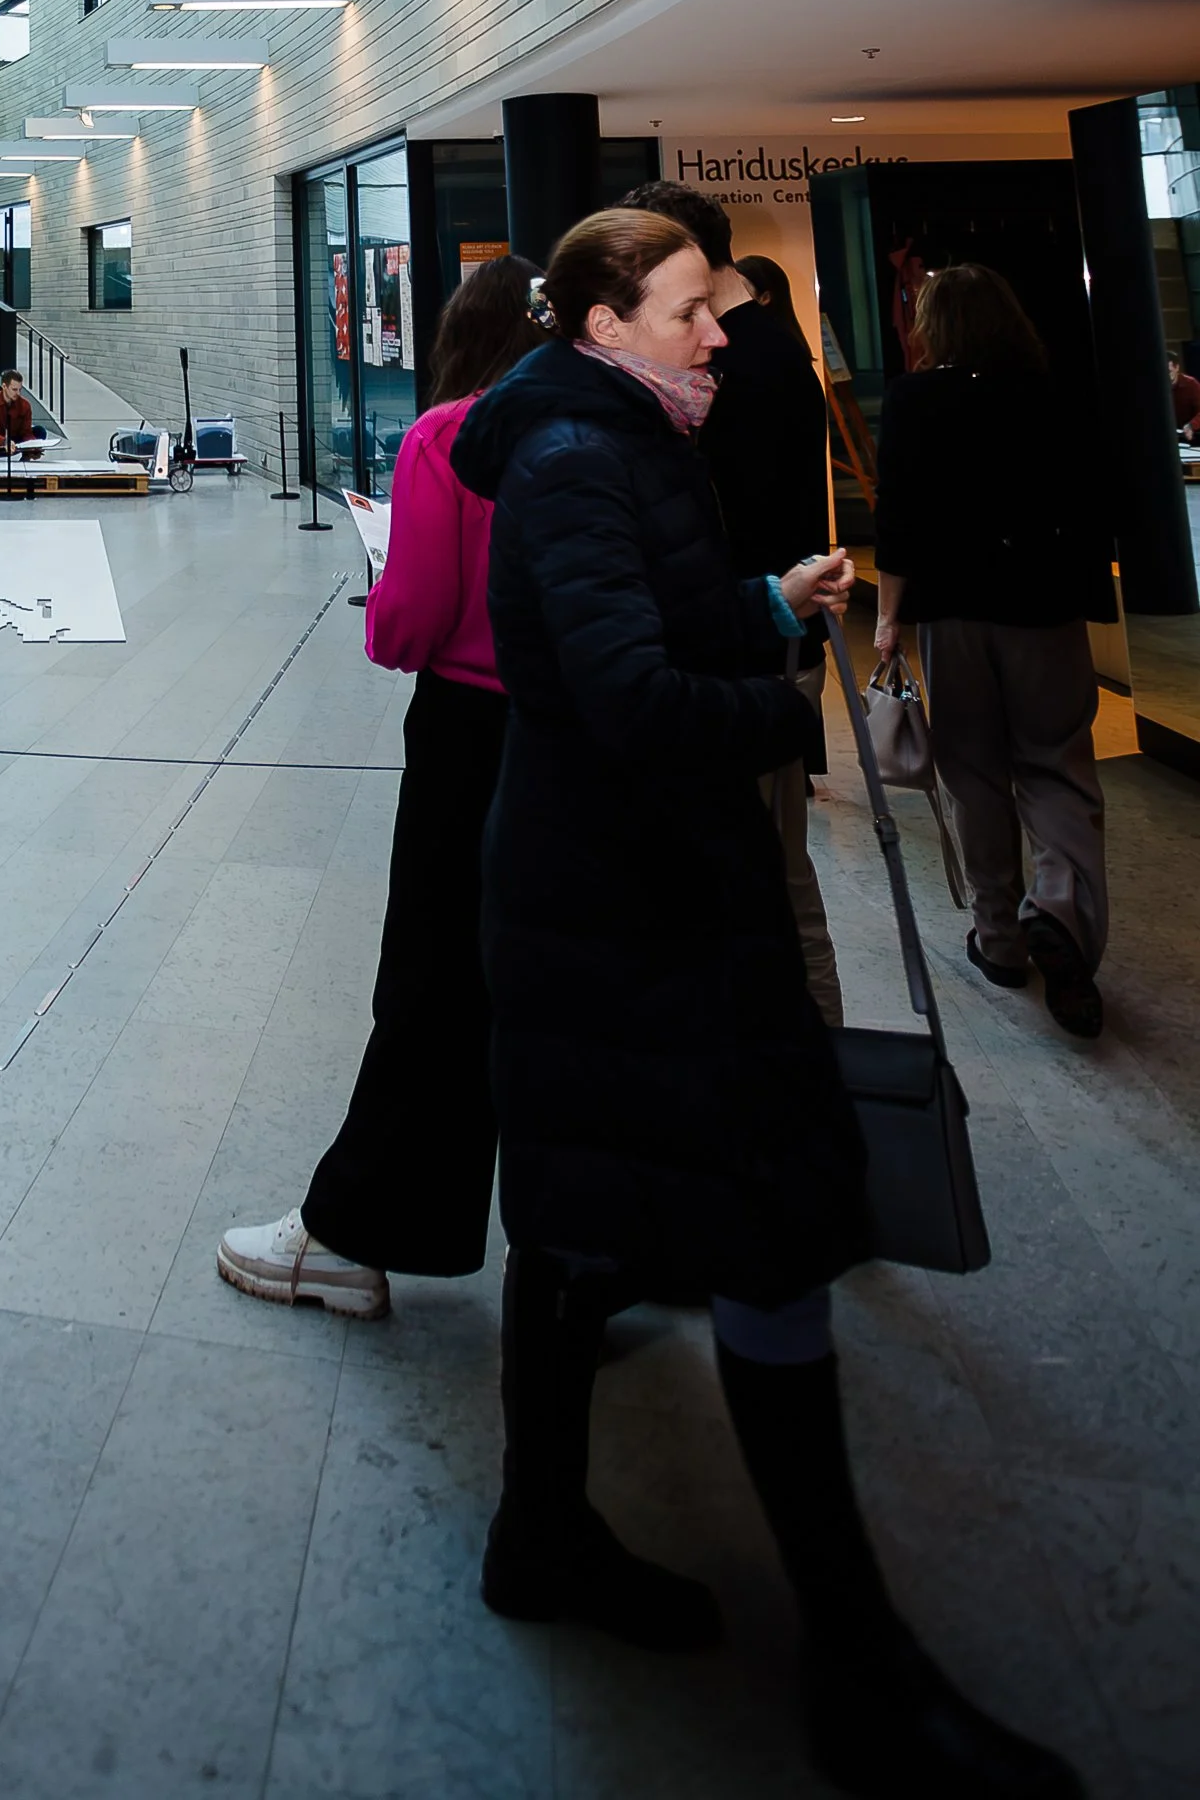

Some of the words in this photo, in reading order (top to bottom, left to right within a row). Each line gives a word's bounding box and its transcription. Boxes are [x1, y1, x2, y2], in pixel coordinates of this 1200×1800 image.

[677, 145, 909, 181] Hariduskesk
[711, 189, 763, 204] cation
[773, 189, 810, 203] Cent
